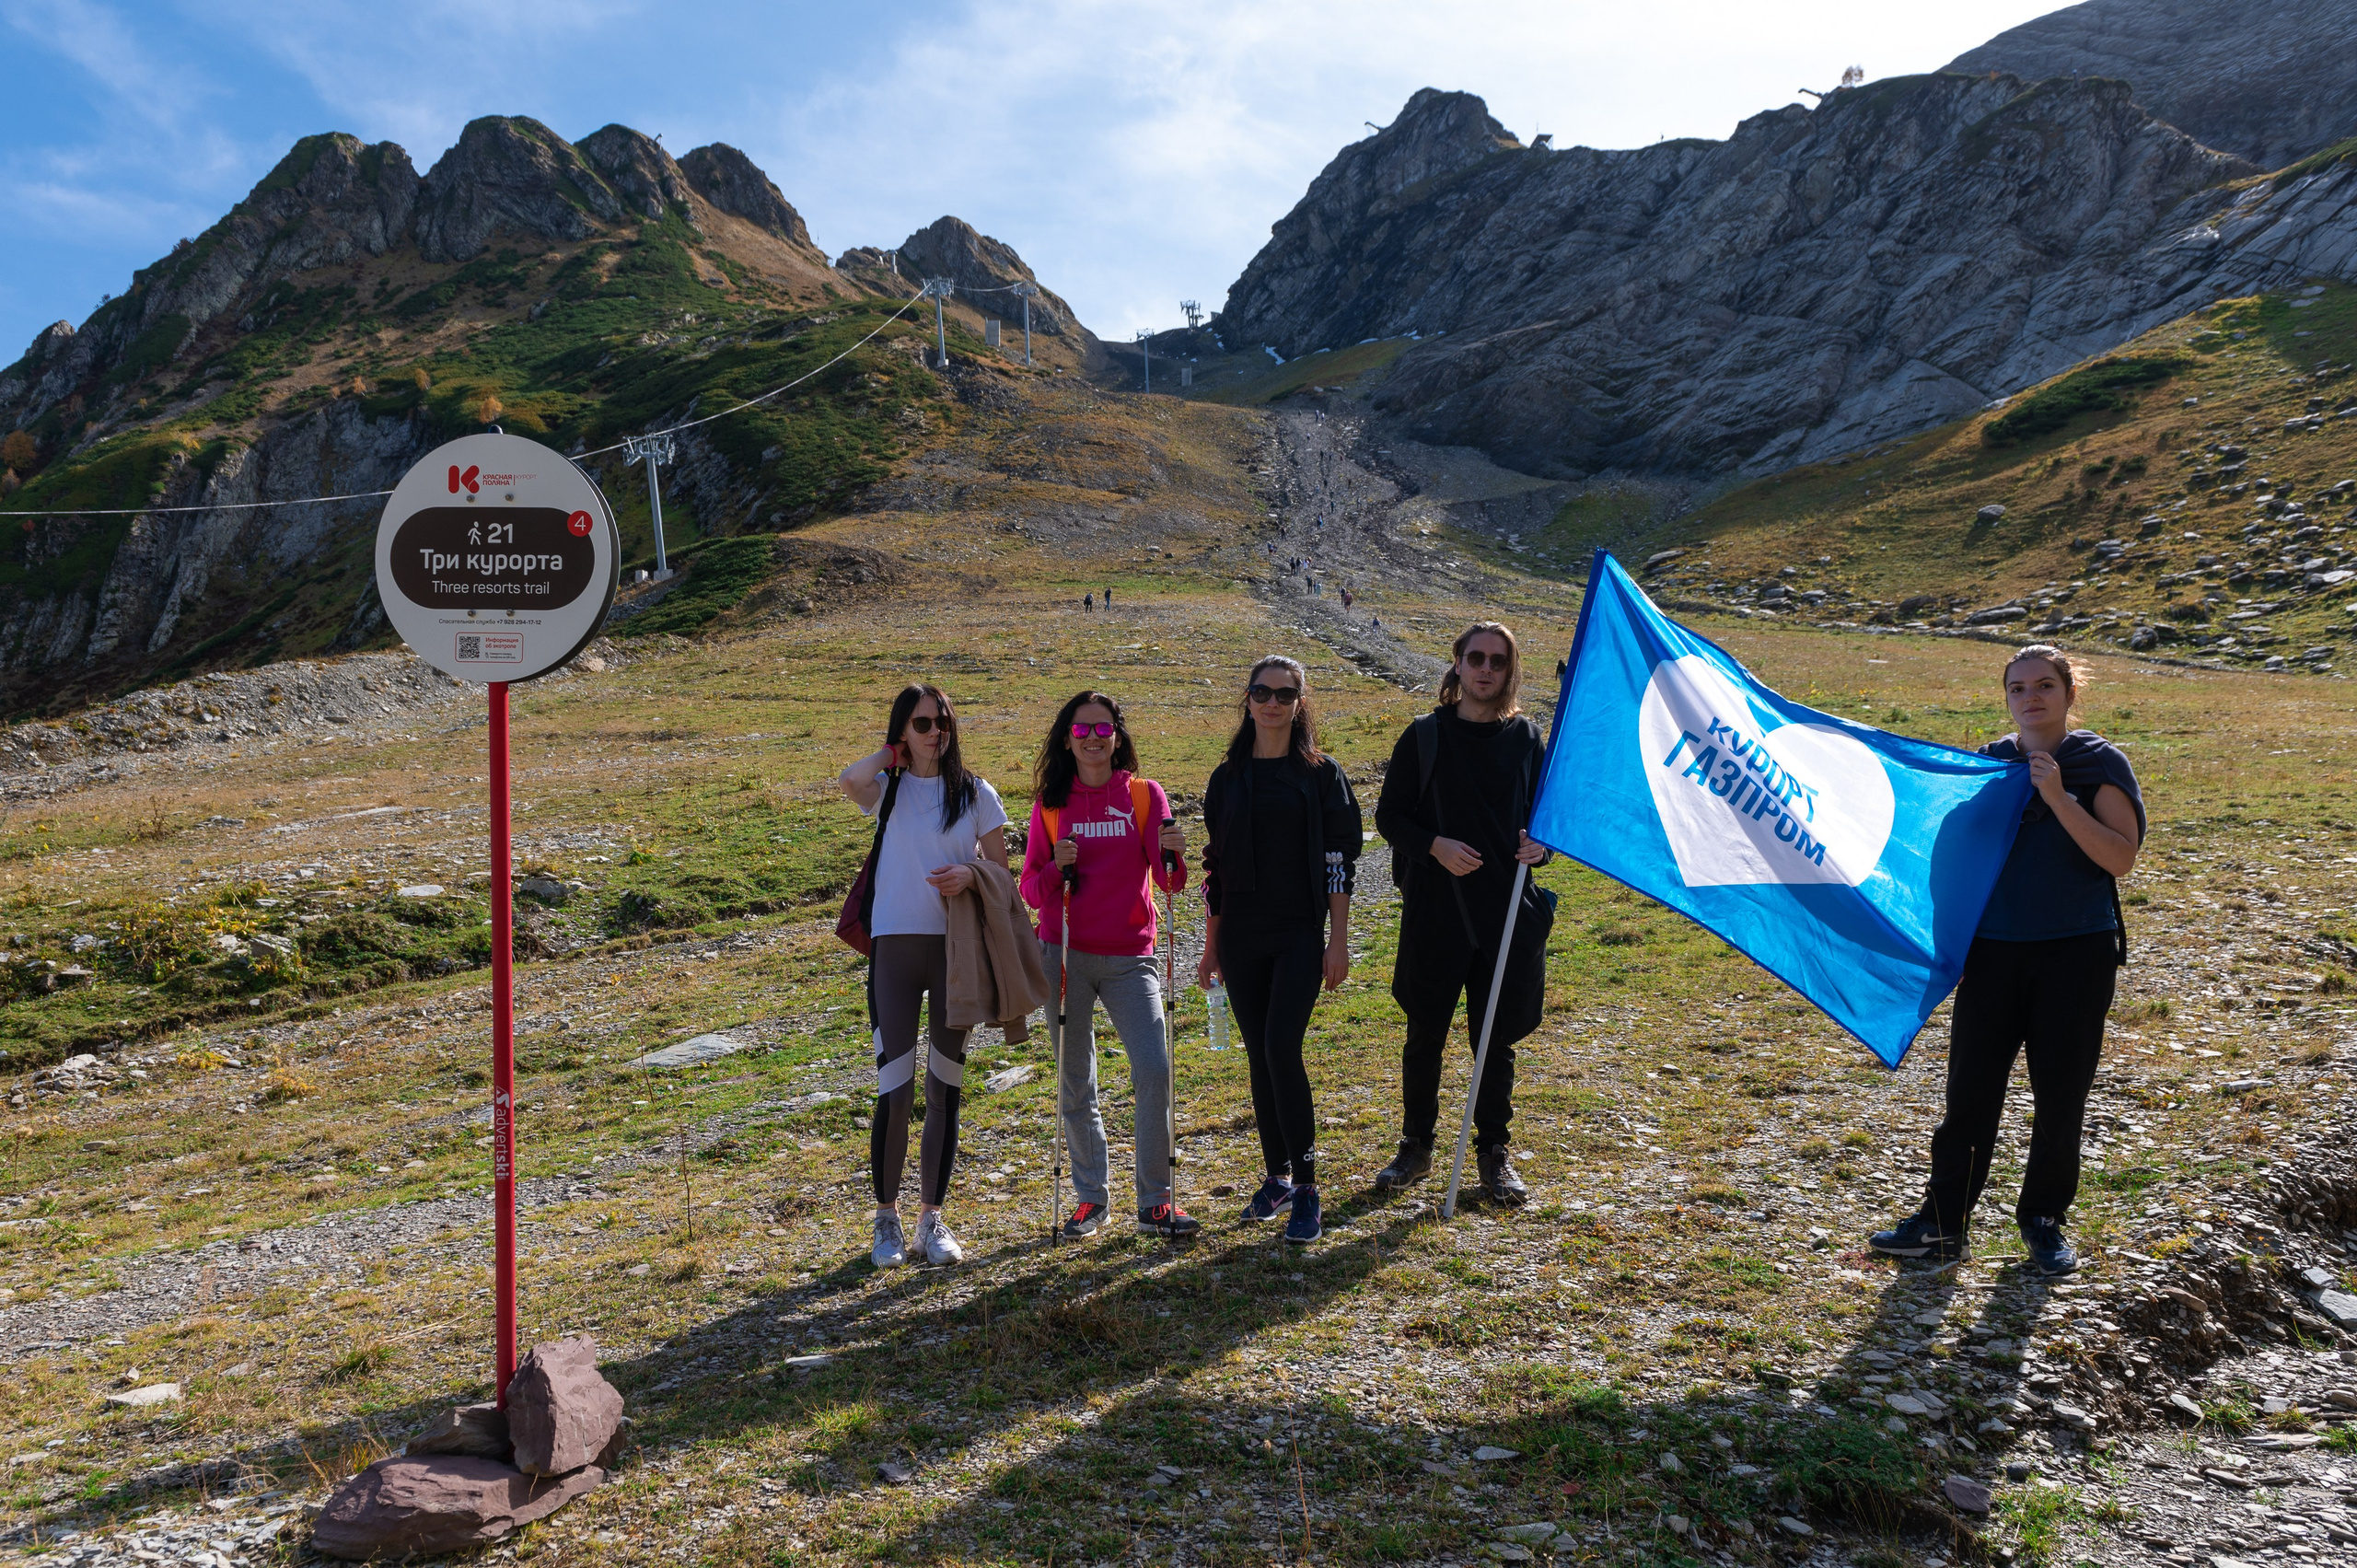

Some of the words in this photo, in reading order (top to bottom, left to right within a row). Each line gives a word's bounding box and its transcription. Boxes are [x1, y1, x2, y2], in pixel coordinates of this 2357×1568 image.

[488, 523, 513, 544] 21
[575, 516, 586, 531] 4
[420, 549, 459, 575] Три
[467, 553, 563, 575] курорта
[432, 580, 469, 594] Three
[472, 581, 520, 594] resorts
[524, 581, 550, 595] trail
[1706, 716, 1819, 823] КУРОРТ
[1663, 729, 1827, 866] ГАЗПРОМ
[1073, 819, 1126, 837] PUMA
[496, 1109, 509, 1176] advertski
